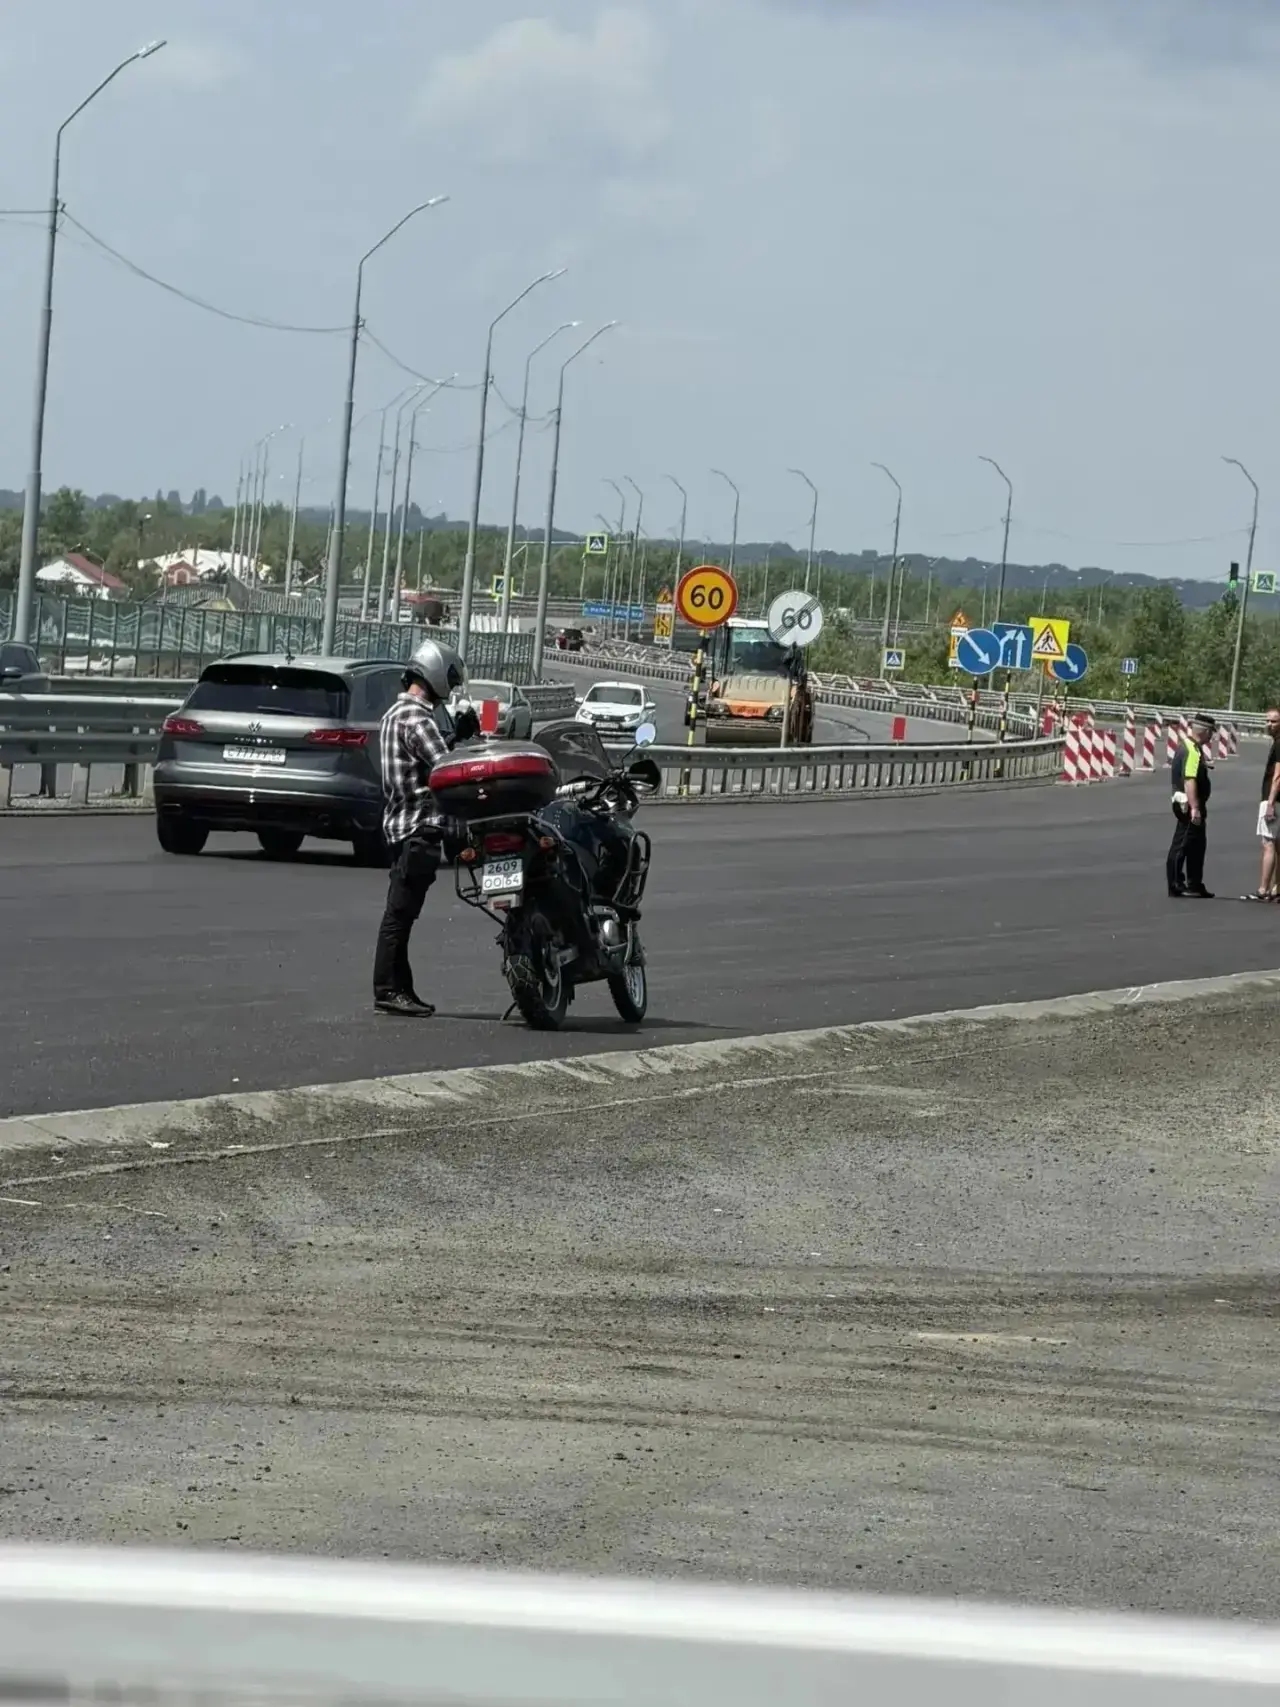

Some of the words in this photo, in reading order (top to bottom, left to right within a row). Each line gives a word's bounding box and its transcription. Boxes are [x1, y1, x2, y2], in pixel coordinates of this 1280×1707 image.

[690, 585, 724, 610] 60
[781, 607, 812, 630] 60
[487, 861, 518, 874] 2609
[505, 875, 519, 886] 64
